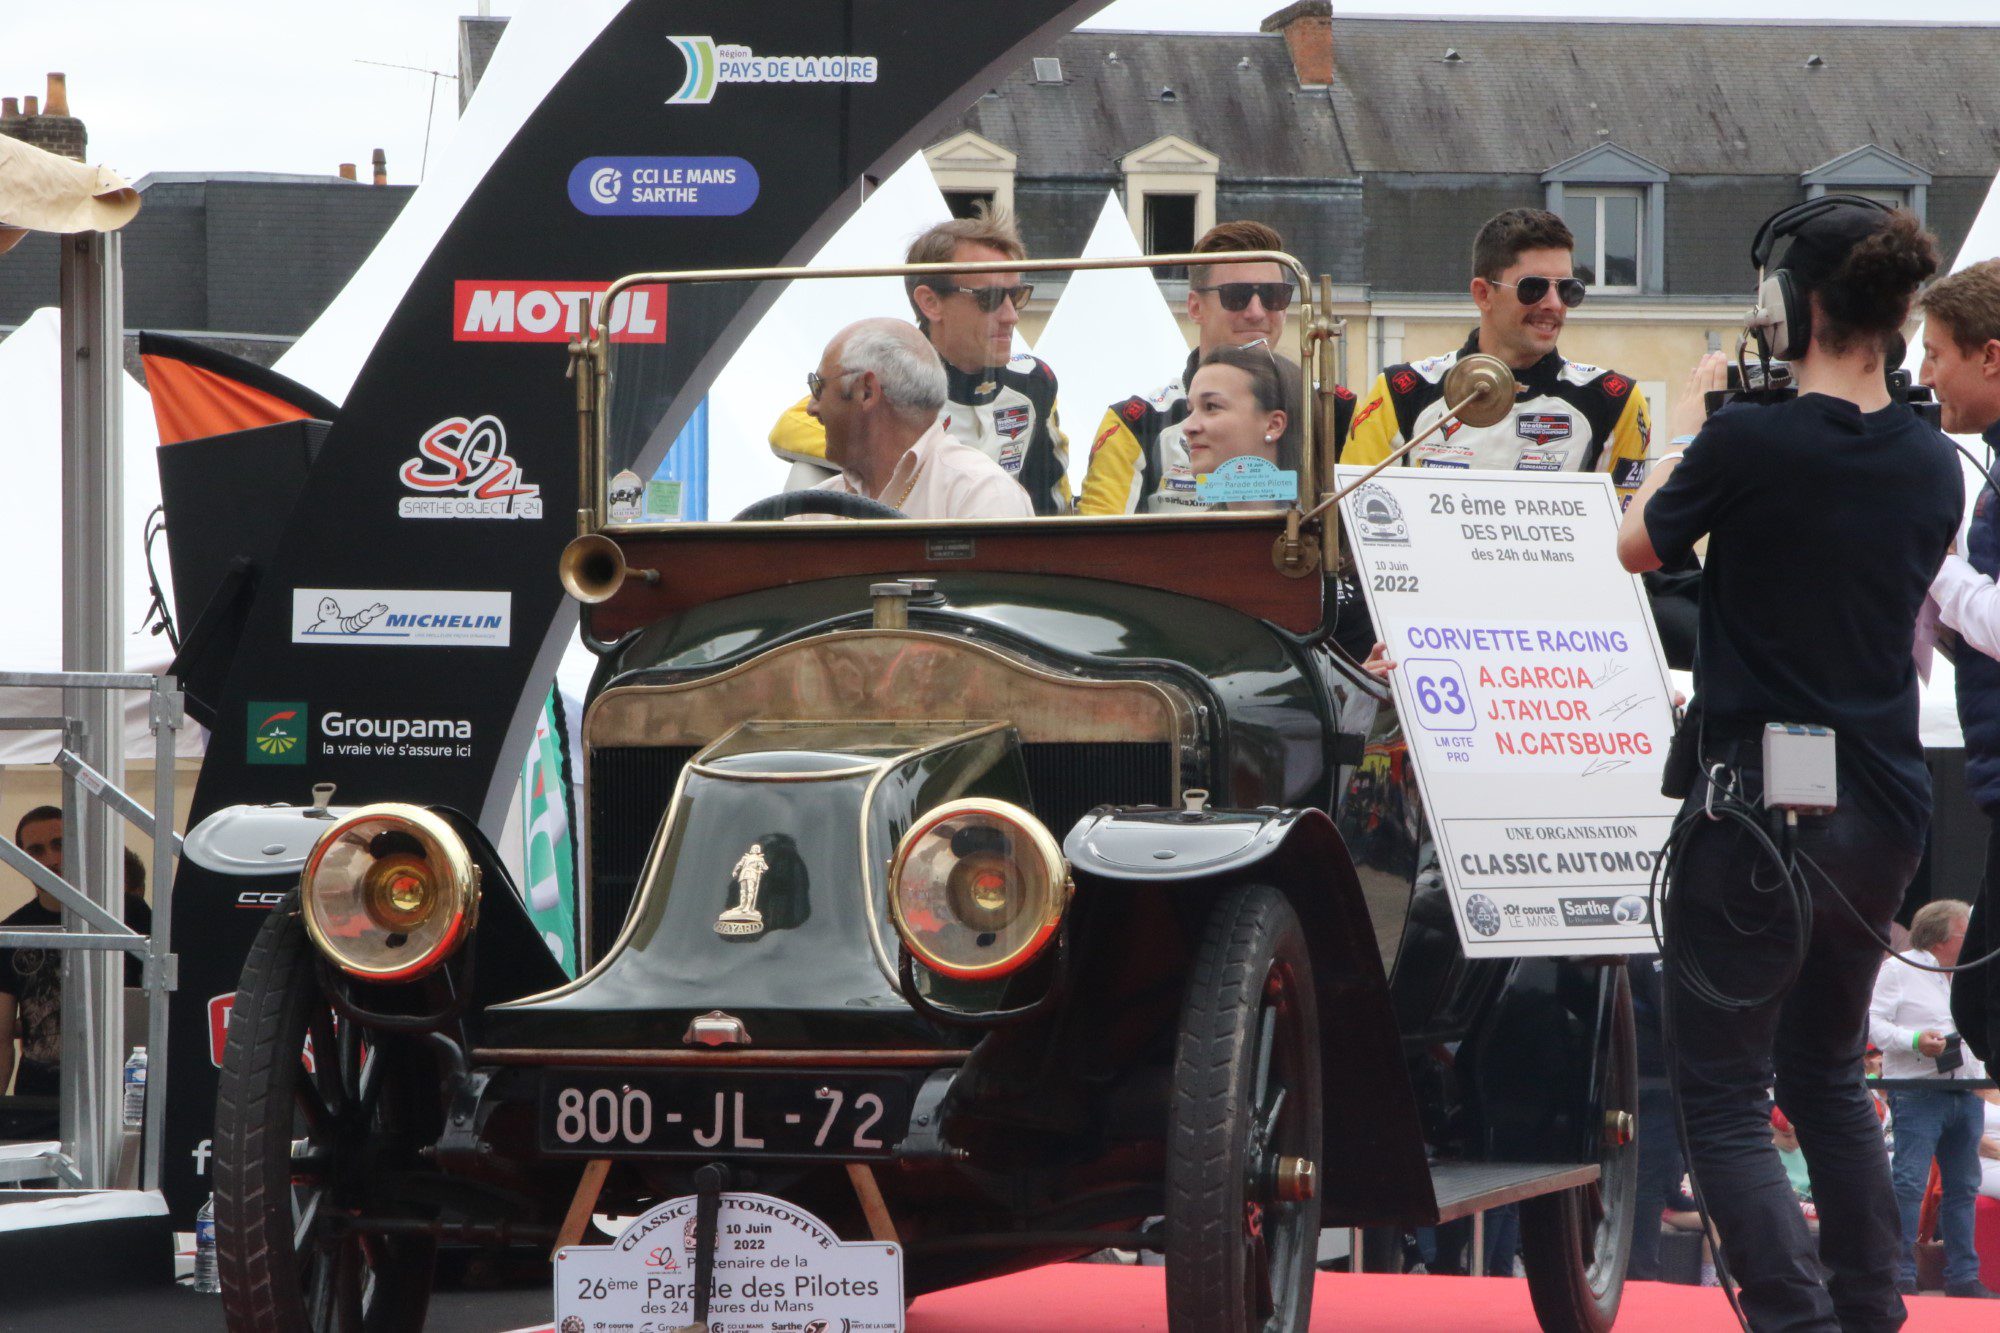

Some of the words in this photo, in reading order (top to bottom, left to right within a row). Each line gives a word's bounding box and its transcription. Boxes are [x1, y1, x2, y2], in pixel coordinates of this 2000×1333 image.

[719, 49, 748, 59] Région
[719, 62, 762, 78] PAYS
[767, 62, 790, 78] DE
[795, 62, 817, 78] LA
[821, 62, 873, 78] LOIRE
[632, 168, 659, 184] CCI
[663, 168, 682, 184] LE
[686, 168, 736, 184] MANS
[632, 187, 698, 203] SARTHE
[462, 290, 657, 334] MOTUL
[404, 501, 453, 514] SARTHE
[524, 501, 540, 514] 24
[1429, 493, 1456, 515] 26
[1461, 493, 1507, 516] ème
[1514, 500, 1588, 517] PARADE
[1461, 524, 1498, 541] DES
[1501, 525, 1575, 542] PILOTES
[1471, 548, 1493, 562] des
[1496, 548, 1520, 562] 24h
[1522, 549, 1540, 562] du
[1542, 550, 1575, 563] Mans
[1375, 560, 1387, 571] 10
[1388, 561, 1409, 571] Juin
[1373, 575, 1420, 593] 2022
[386, 614, 503, 629] MICHELIN
[1407, 626, 1534, 651] CORVETTE
[1536, 630, 1629, 652] RACING
[1479, 666, 1594, 689] A.GARCIA
[1416, 675, 1467, 715] 63
[1487, 699, 1592, 721] J.TAYLOR
[321, 711, 471, 743] Groupama
[323, 743, 334, 755] la
[338, 743, 371, 756] vraie
[375, 743, 395, 756] vie
[399, 743, 453, 757] s'assure
[456, 744, 471, 757] ici
[1434, 736, 1451, 748] LM
[1451, 737, 1475, 748] GTE
[1495, 732, 1653, 756] N.CATSBURG
[1447, 752, 1471, 763] PRO
[1505, 827, 1535, 840] UNE
[1536, 825, 1638, 840] ORGANISATION
[1460, 853, 1552, 875] CLASSIC
[1557, 850, 1669, 874] AUTOMOT
[1522, 904, 1556, 915] course
[1565, 900, 1611, 916] Sarthe
[1509, 916, 1528, 928] LE
[1530, 914, 1560, 927] MANS
[621, 1204, 692, 1252] CLASSIC
[726, 1224, 741, 1234] 10
[745, 1223, 773, 1234] Juin
[734, 1239, 765, 1250] 2022
[770, 1254, 790, 1268] de
[795, 1254, 808, 1268] la
[578, 1277, 638, 1300] 26ème
[742, 1276, 785, 1298] des
[795, 1275, 879, 1298] Pilotes
[641, 1301, 666, 1314] des
[671, 1301, 689, 1314] 24
[750, 1301, 769, 1312] du
[774, 1300, 814, 1312] Mans
[771, 1322, 803, 1330] Sarthe
